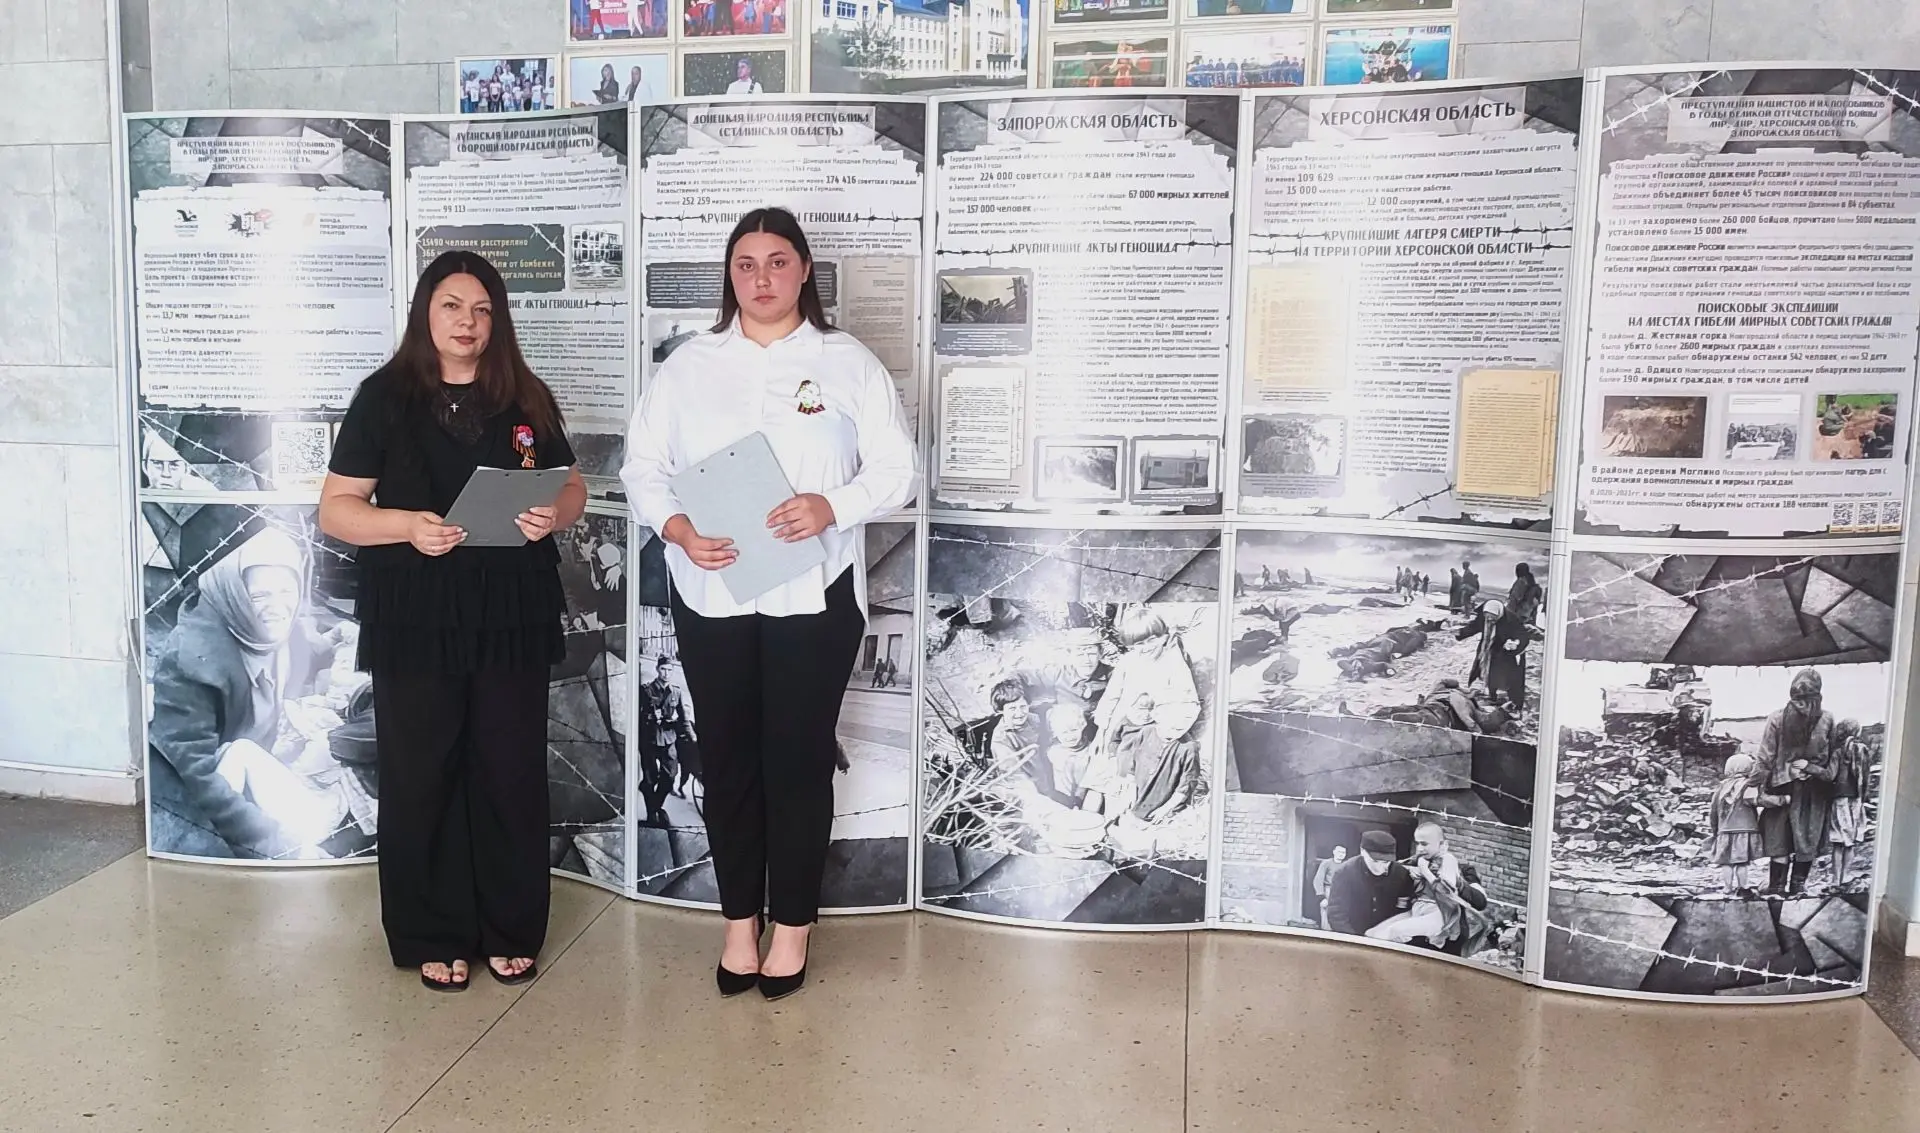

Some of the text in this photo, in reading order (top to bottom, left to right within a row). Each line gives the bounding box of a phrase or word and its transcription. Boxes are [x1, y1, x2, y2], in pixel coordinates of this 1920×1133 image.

[1681, 101, 1755, 109] ПРЕСТУПЛЕНИЯ
[1831, 100, 1885, 108] ПОСОБНИКОВ
[693, 113, 869, 125] ДОНЕЦКАЯ НАРОДНАЯ РЕСПУБЛИКА
[1320, 102, 1516, 126] ХЕРСОНСКАЯ ОБЛАСТЬ
[1729, 110, 1772, 118] ВЕЛИКОЙ
[1774, 110, 1847, 118] ОТЕЧЕСТВЕННОЙ
[997, 114, 1178, 131] ЗАПОРОЖСКАЯ ОБЛАСТЬ
[1758, 119, 1817, 128] ХЕРСОНСКАЯ
[504, 129, 546, 139] НАРОДНАЯ
[719, 126, 844, 137] (СТАЛИНСКАЯ ОБЛАСТЬ)
[1731, 129, 1842, 138] ЗАПОРОЖСКАЯ ОБЛАСТЬ
[826, 175, 857, 184] 174 416
[980, 172, 994, 180] 224
[996, 172, 1013, 180] 000
[1068, 172, 1111, 180] граждан
[1298, 173, 1314, 182] 109
[1318, 173, 1334, 182] 629
[1652, 169, 1791, 180] «Поисковое движение России»
[1128, 190, 1138, 199] 67
[1140, 190, 1156, 199] 000
[1156, 192, 1190, 200] мирных
[1192, 190, 1230, 199] жителей
[1287, 186, 1317, 195] 15 000
[1652, 190, 1710, 199] объединяет
[1712, 190, 1740, 198] более
[1742, 190, 1752, 198] 45
[1783, 190, 1837, 198] поисковиков
[682, 197, 711, 206] 252 259
[1368, 197, 1377, 206] 12
[1380, 197, 1399, 205] 000
[443, 205, 466, 213] 99 113
[967, 205, 1032, 214] 157 000 человек
[804, 212, 859, 223] ГЕНОЦИДА
[1643, 218, 1697, 226] захоронено
[1722, 215, 1738, 224] 260
[1740, 215, 1756, 223] 000
[1793, 217, 1836, 226] прочитано
[1324, 226, 1501, 241] КРУПНЕЙШИЕ ЛАГЕРЯ СМЕРТИ
[1608, 227, 1723, 238] установлено 15 000
[445, 239, 478, 247] человек
[481, 239, 528, 248] расстреляно
[1086, 242, 1117, 253] АКТЫ
[1120, 242, 1178, 253] ГЕНОЦИДА
[1605, 243, 1650, 252] Поисковое
[1652, 244, 1696, 252] движение
[1698, 242, 1726, 251] России
[1294, 242, 1533, 257] НА ТЕРРИТОРИИ ХЕРСОНСКОЙ ОБЛАСТИ
[1604, 264, 1717, 275] гибели мирных советских
[501, 272, 534, 281] ергались
[524, 299, 548, 309] АКТЫ
[550, 299, 589, 309] ГЕНОЦИДА
[1698, 302, 1839, 313] ПОИСКОВЫЕ ЭКСПЕДИЦИИ
[1628, 316, 1893, 327] НА МЕСТАХ ГИБЕЛИ МИРНЫХ СОВЕТСКИХ ГРАЖДАН
[1651, 331, 1728, 341] Жестяная горка
[1624, 341, 1776, 351] убито 2600 мирных граждан
[1691, 353, 1750, 362] обнаружены
[1790, 352, 1802, 361] 542
[1816, 366, 1862, 375] обнаружено
[1623, 375, 1639, 383] 190
[1641, 376, 1678, 385] мирных
[1600, 466, 1634, 475] районе
[1636, 468, 1677, 476] деревни
[1680, 467, 1721, 475] Моглино
[1592, 476, 1755, 487] одержания военнопленных мирных
[1686, 500, 1743, 509] обнаружены
[1782, 500, 1796, 508] 188
